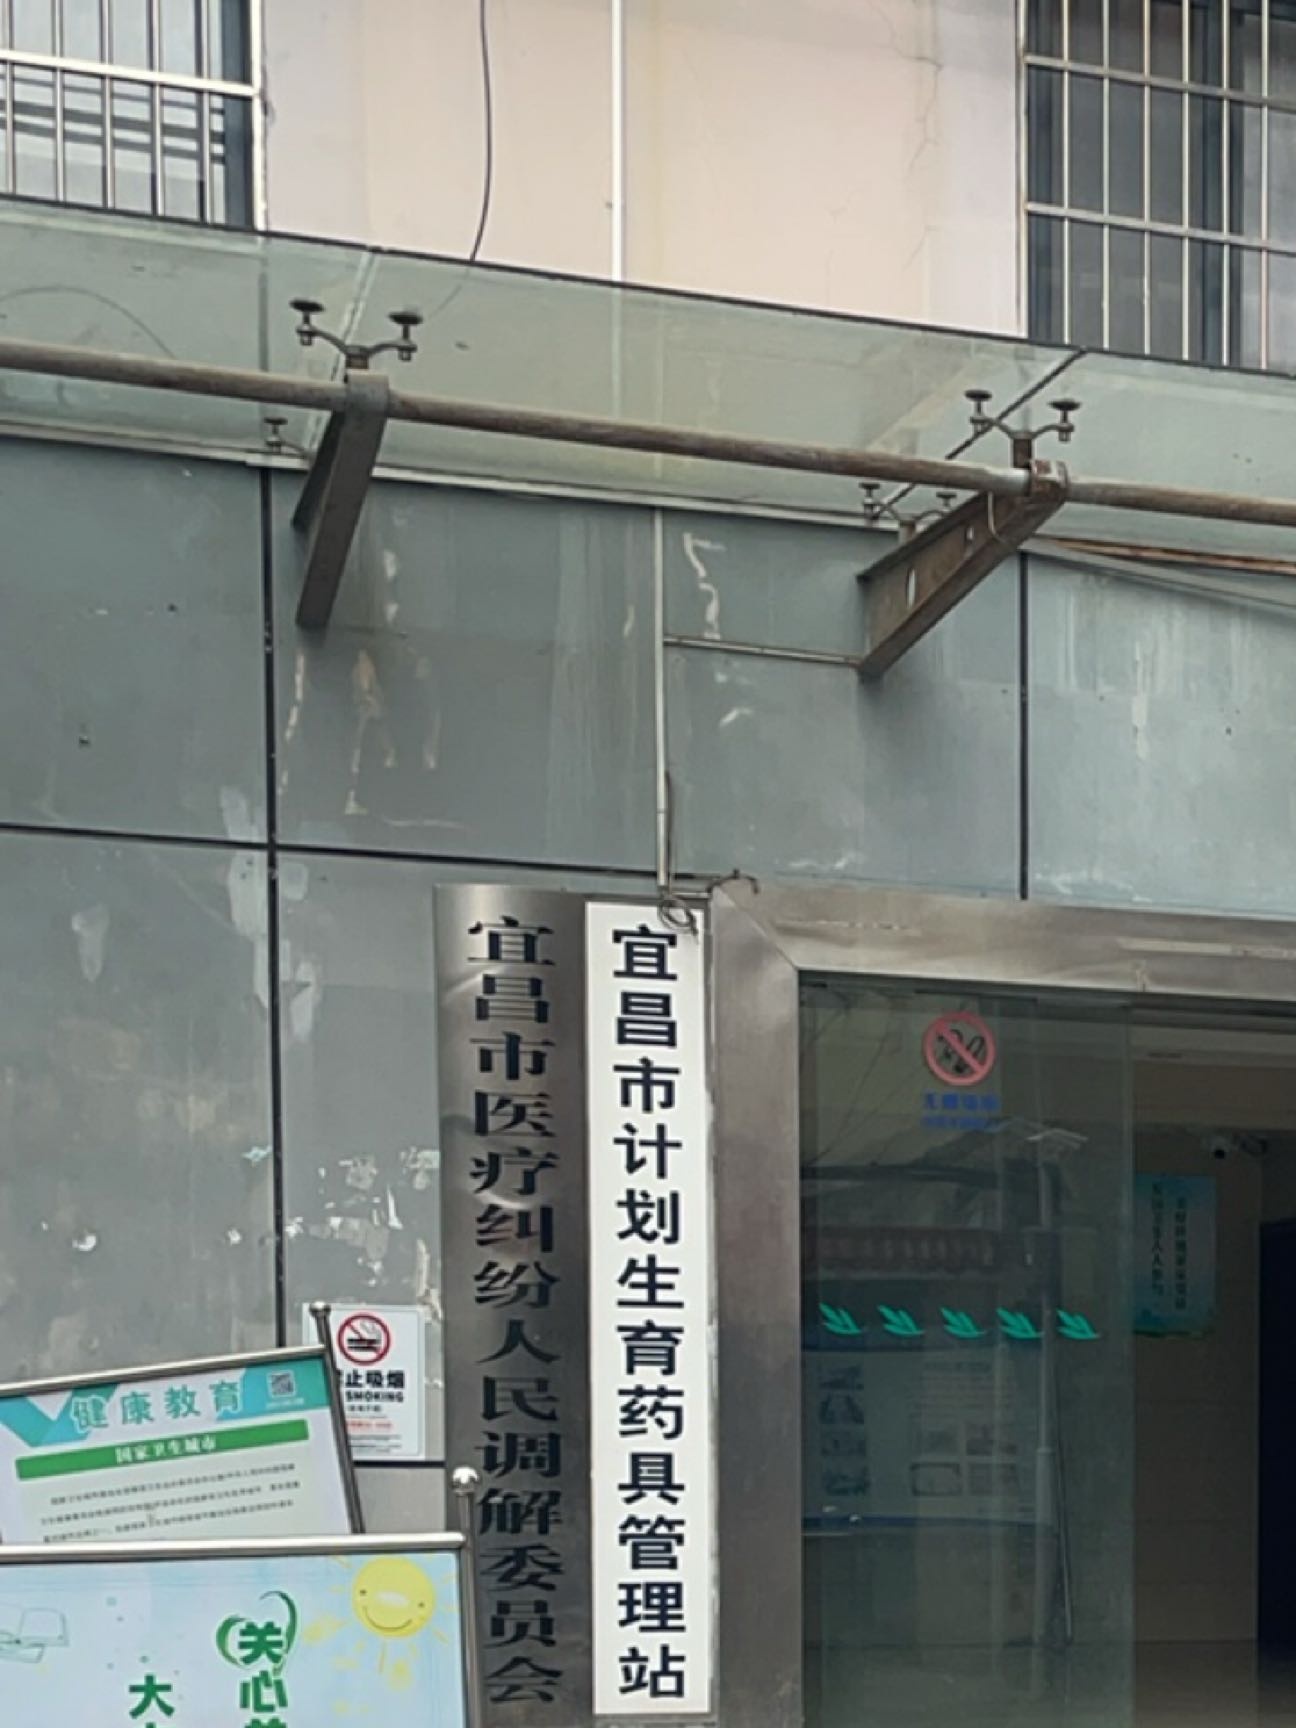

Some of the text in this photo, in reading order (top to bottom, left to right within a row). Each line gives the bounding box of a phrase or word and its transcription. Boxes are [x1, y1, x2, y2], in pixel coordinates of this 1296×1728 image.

[467, 915, 565, 1702] 宜昌市医疗纠纷人民调解委员会
[613, 925, 686, 1698] 宜昌市计划生育药具管理站
[338, 1369, 405, 1389] 止吸烟
[345, 1391, 404, 1402] SMOKING
[72, 1380, 241, 1431] 健康教育
[115, 1436, 217, 1464] 国家卫生城市
